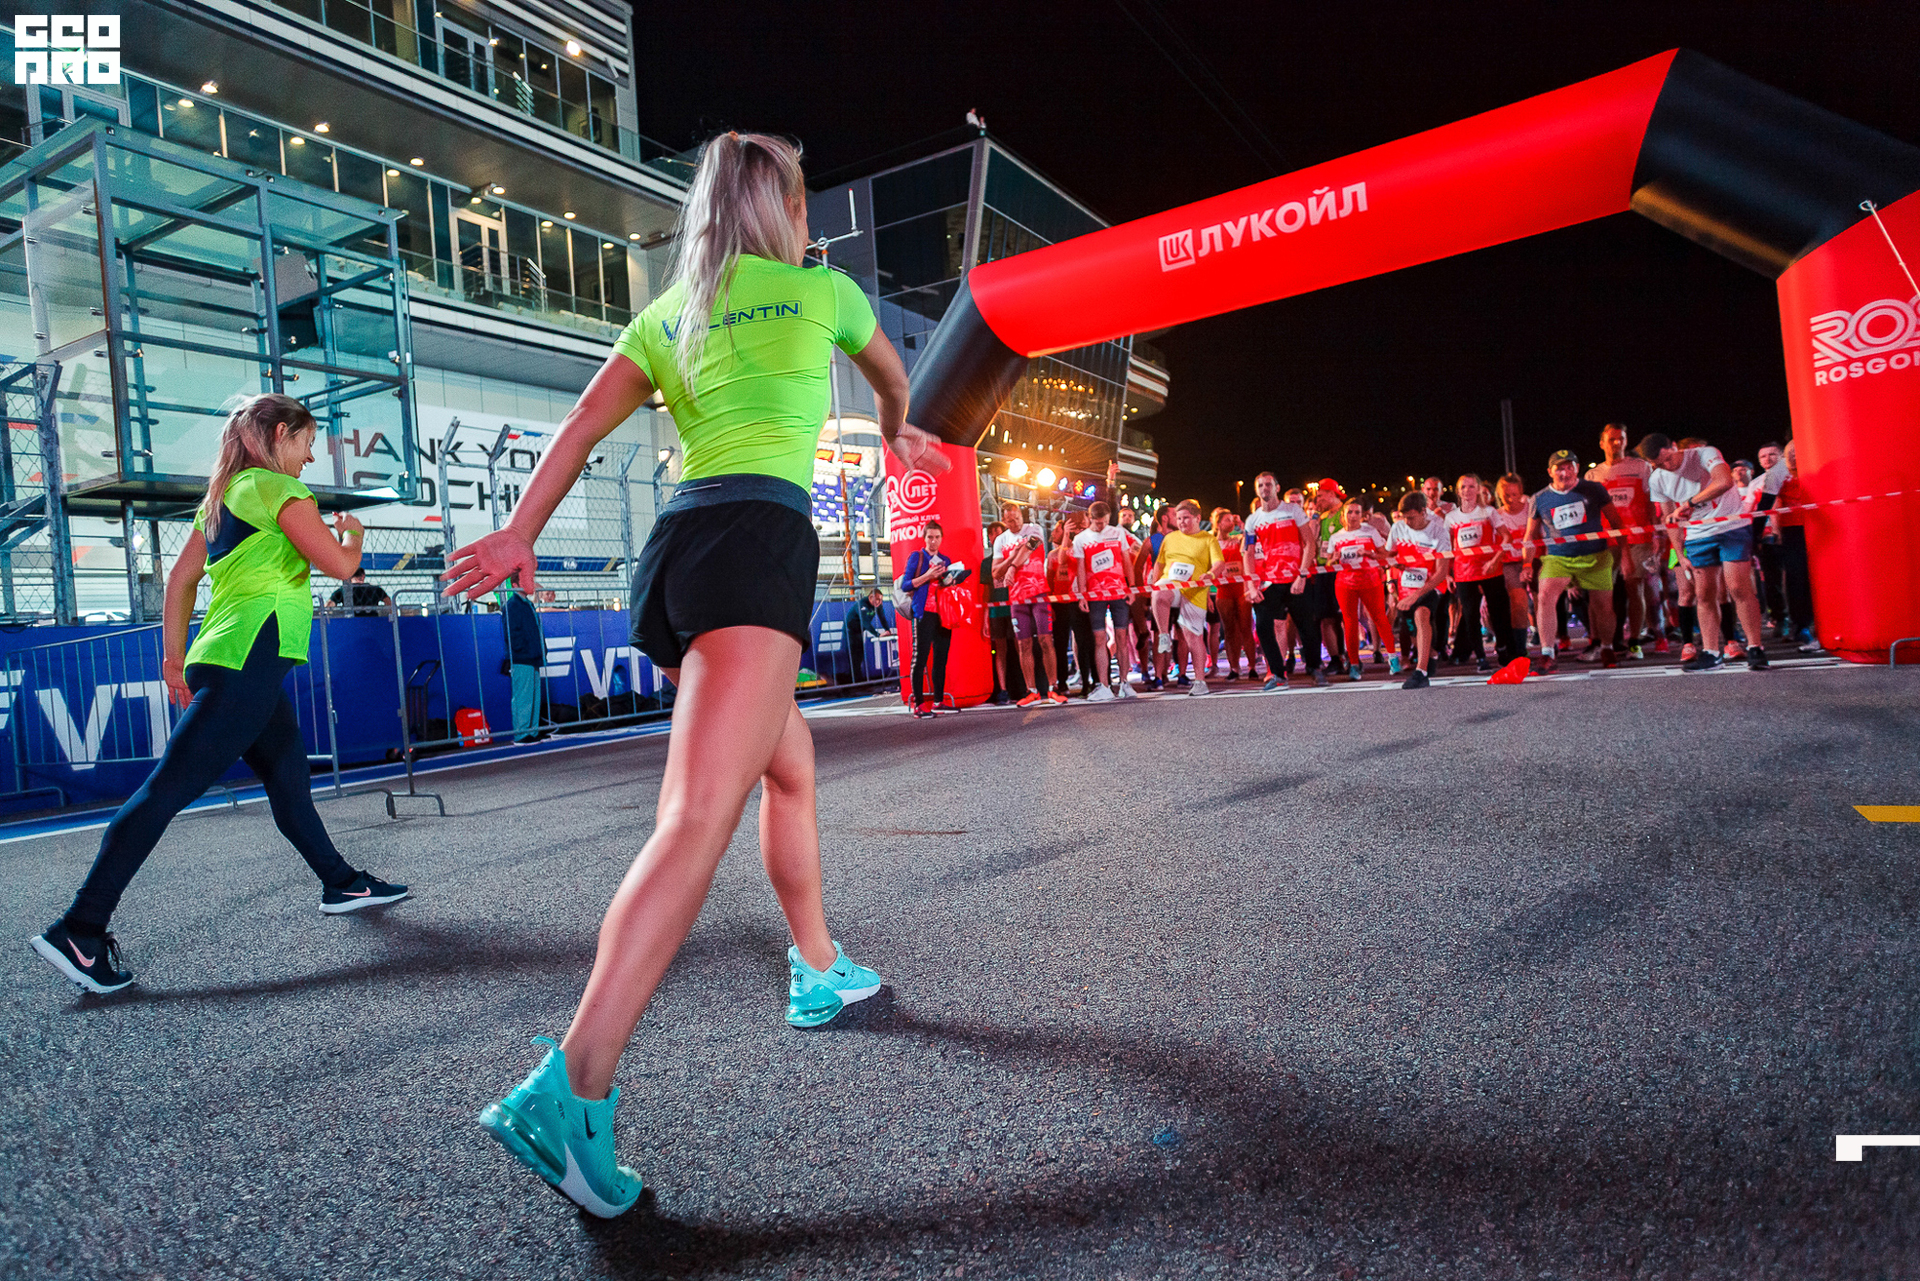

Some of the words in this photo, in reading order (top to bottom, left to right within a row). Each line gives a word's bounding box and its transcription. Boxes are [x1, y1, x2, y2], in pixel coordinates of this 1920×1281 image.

[1198, 181, 1368, 257] ЛУКОЙЛ
[477, 443, 541, 469] YO
[909, 484, 938, 498] ЛЕТ
